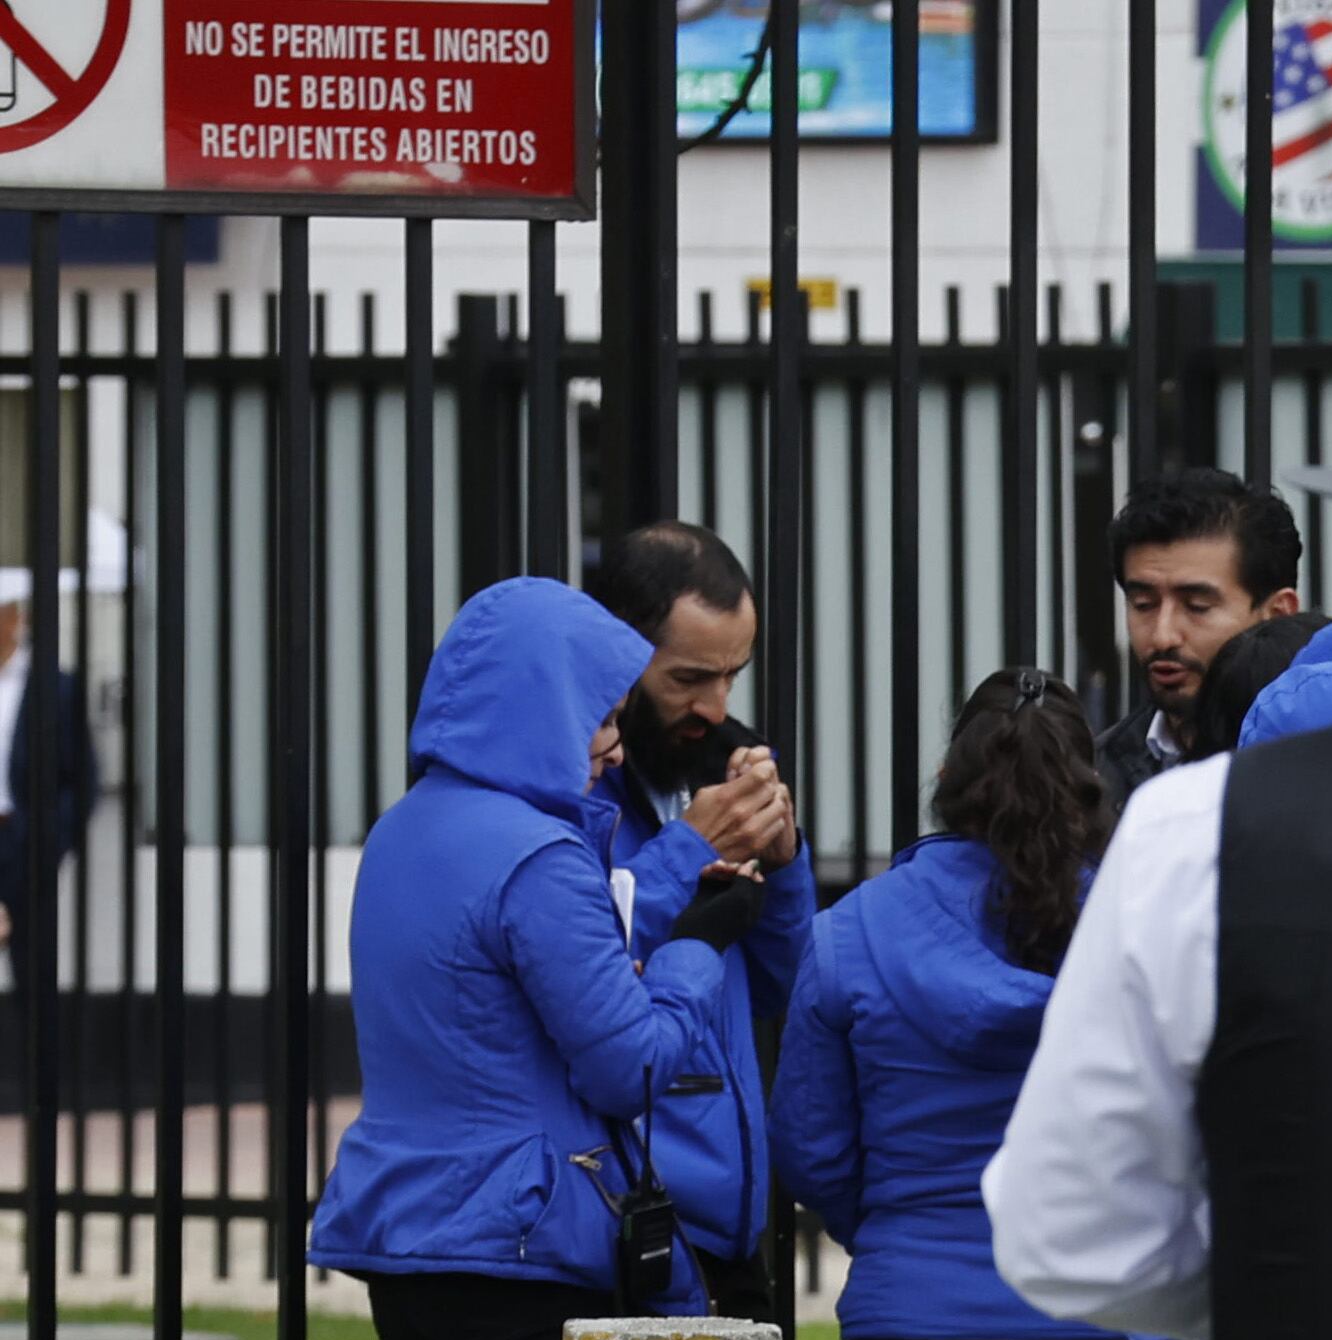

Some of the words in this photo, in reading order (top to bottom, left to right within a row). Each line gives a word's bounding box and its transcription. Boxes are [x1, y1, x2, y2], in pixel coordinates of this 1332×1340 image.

[185, 21, 223, 56] NO
[231, 22, 265, 58] SE
[272, 23, 387, 61] PERMITE
[395, 27, 426, 62] EL
[434, 28, 549, 65] INGRESO
[254, 74, 291, 109] DE
[301, 75, 426, 112] BEBIDAS
[436, 78, 473, 114] EN
[201, 123, 387, 162] RECIPIENTES
[395, 128, 536, 166] ABIERTOS
